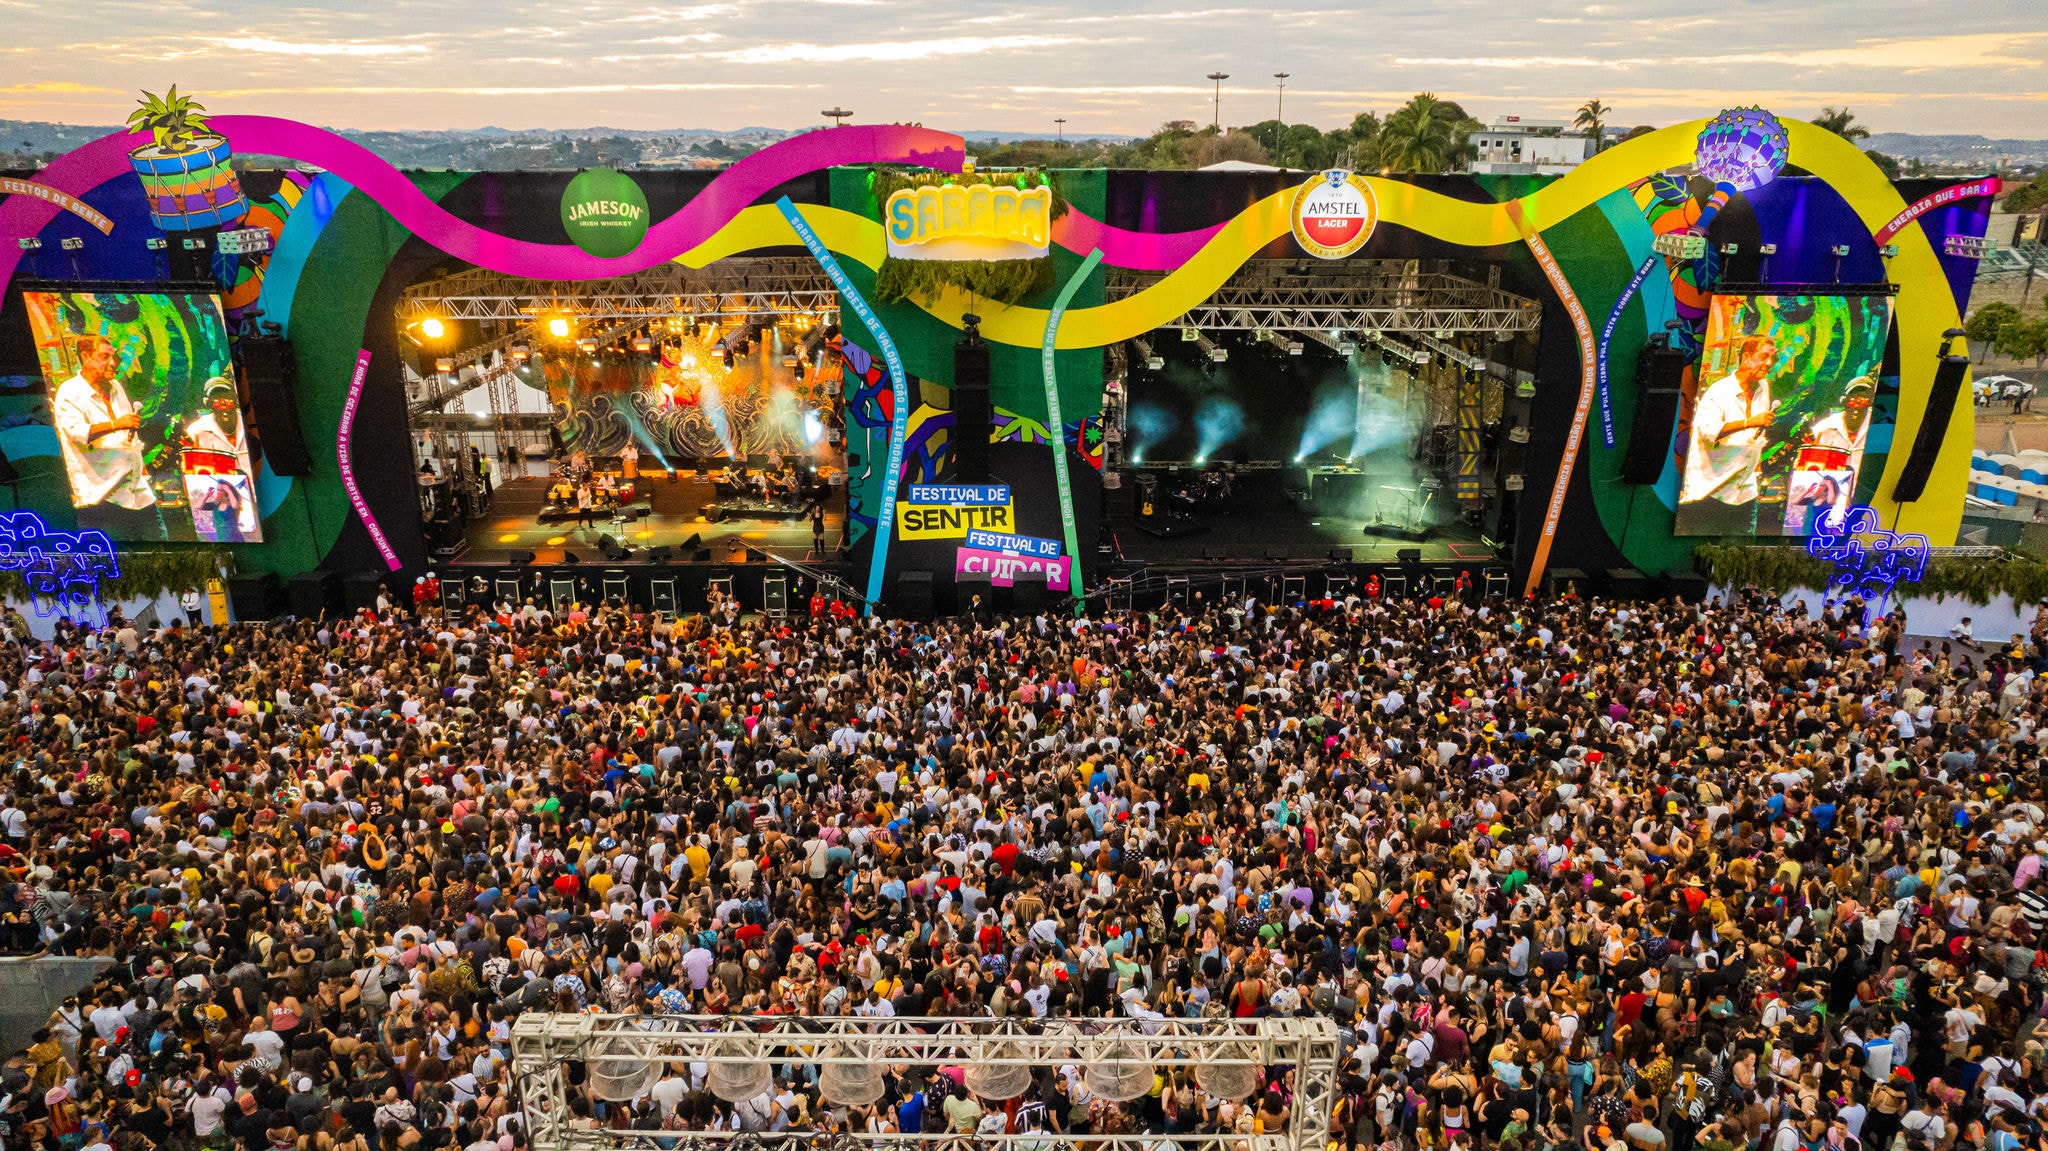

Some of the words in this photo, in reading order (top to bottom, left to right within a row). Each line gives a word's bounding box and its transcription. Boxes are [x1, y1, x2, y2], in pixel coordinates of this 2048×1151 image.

[4, 181, 49, 199] FEITOS
[52, 193, 68, 206] DE
[71, 202, 108, 229] GENTE
[568, 200, 641, 221] JAMESON
[1308, 202, 1360, 215] AMSTEL
[1887, 199, 1933, 233] ENERGIA
[1935, 189, 1955, 203] QUE
[1318, 219, 1348, 228] LAGER
[791, 216, 823, 255] SARARÁ
[819, 255, 830, 264] É
[1541, 255, 1551, 263] E
[827, 264, 844, 285] UMA
[1546, 261, 1573, 300] PRODUÇÃO
[842, 285, 868, 317] IDEIA
[1617, 288, 1634, 310] CORRE
[866, 317, 881, 332] DE
[1604, 317, 1617, 338] GRITA
[1044, 346, 1053, 358] EM
[1583, 336, 1594, 364] ENTRE
[353, 365, 365, 386] HORA
[878, 331, 907, 403] VALORIZAÇÃO
[1044, 359, 1054, 386] VIVER
[350, 386, 359, 397] DE
[1580, 366, 1594, 410] SENTIDOS
[340, 397, 355, 435] CELEBRAR
[1575, 411, 1585, 422] DE
[1603, 410, 1611, 422] QUE
[1054, 434, 1063, 445] SE
[1568, 424, 1581, 450] UNIÃO
[1605, 424, 1614, 444] GENTE
[339, 444, 348, 464] VIDA
[889, 418, 905, 476] LIBERDADE
[1564, 452, 1574, 463] DE
[342, 464, 351, 475] DE
[345, 476, 360, 501] PERTO
[887, 479, 897, 492] DE
[912, 487, 984, 502] FESTIVAL
[987, 488, 1006, 502] DE
[1061, 486, 1069, 497] DE
[1550, 464, 1571, 519] EXPERIÊNCIA
[358, 506, 369, 518] EM
[903, 506, 1008, 532] SENTIR
[1063, 498, 1072, 520] HORA
[1545, 520, 1556, 536] UMA
[969, 532, 1036, 553] FESTIVAL
[1039, 540, 1058, 556] DE
[370, 806, 383, 815] 32
